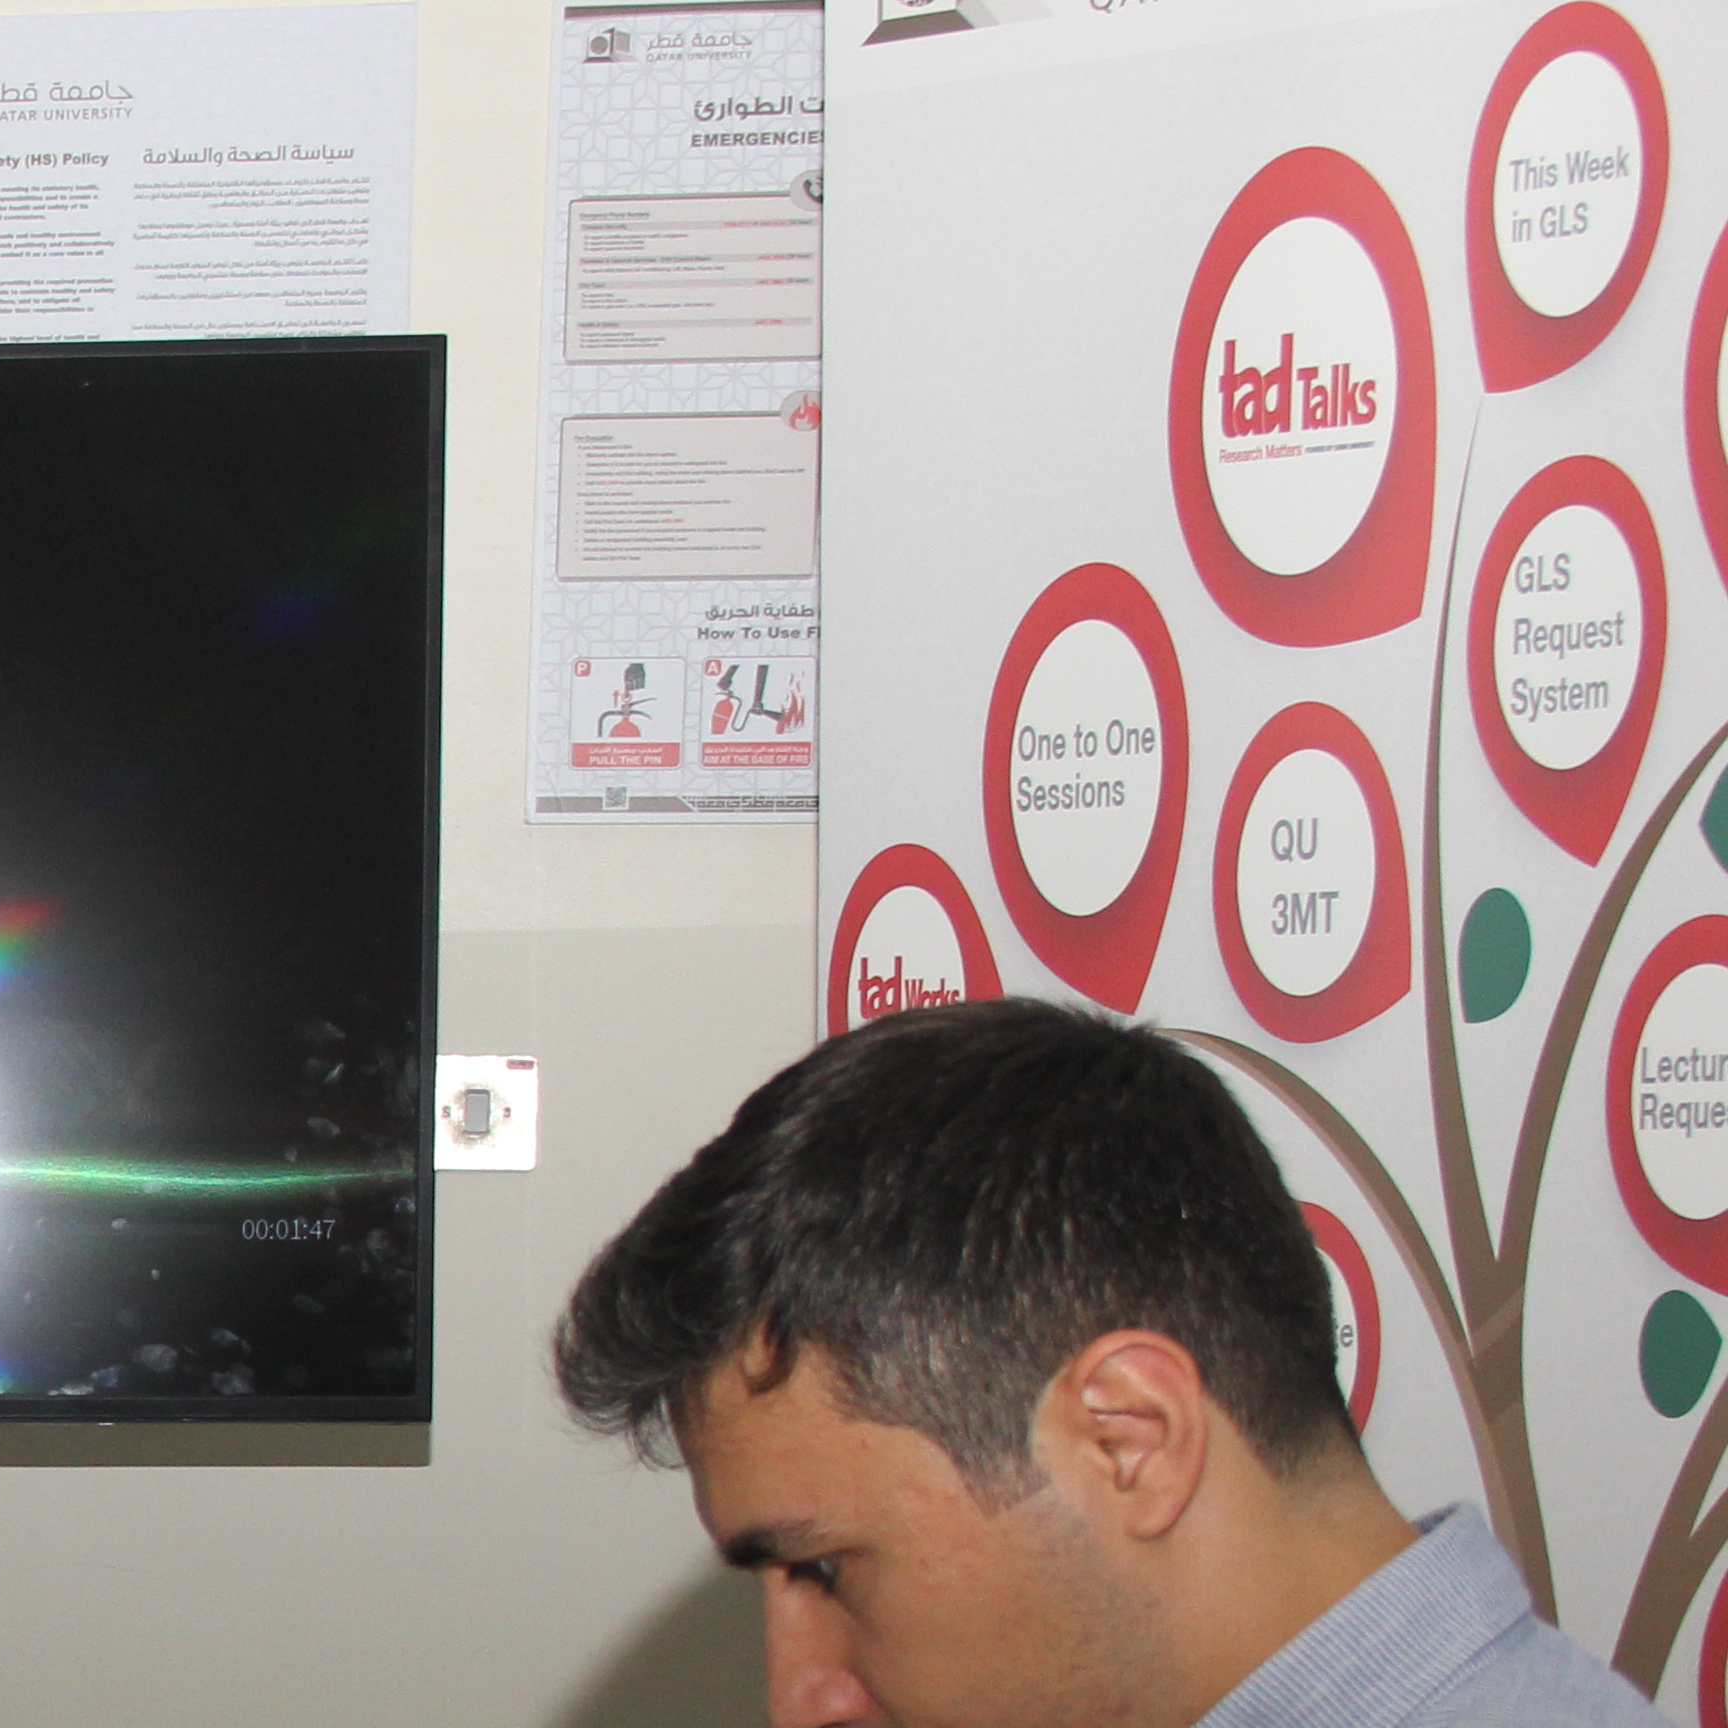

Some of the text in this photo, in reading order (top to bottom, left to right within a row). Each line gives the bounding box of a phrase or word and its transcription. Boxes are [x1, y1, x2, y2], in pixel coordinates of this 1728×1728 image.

[49, 80, 134, 105] جامعة
[43, 106, 133, 122] UNIVERSITY
[25, 153, 58, 169] (HS)
[62, 151, 109, 168] Policy
[143, 145, 354, 167] سياسة الصحة والسلامة
[1509, 145, 1631, 192] This Week
[1510, 202, 1588, 243] in GLS
[1219, 332, 1377, 438] tad Talks
[1513, 553, 1572, 594] GLS
[697, 627, 735, 640] How
[740, 627, 761, 639] To
[767, 627, 801, 639] Use
[1512, 611, 1625, 662] Request
[1510, 676, 1610, 724] System
[1017, 719, 1155, 763] One to One
[1016, 773, 1126, 813] Sessions
[1269, 817, 1319, 863] QU
[1270, 891, 1340, 936] 3MT
[859, 955, 902, 1019] tad
[1639, 1046, 1728, 1084] Lectur
[1639, 1093, 1728, 1138] Reque
[241, 1216, 335, 1242] 00:01:47
